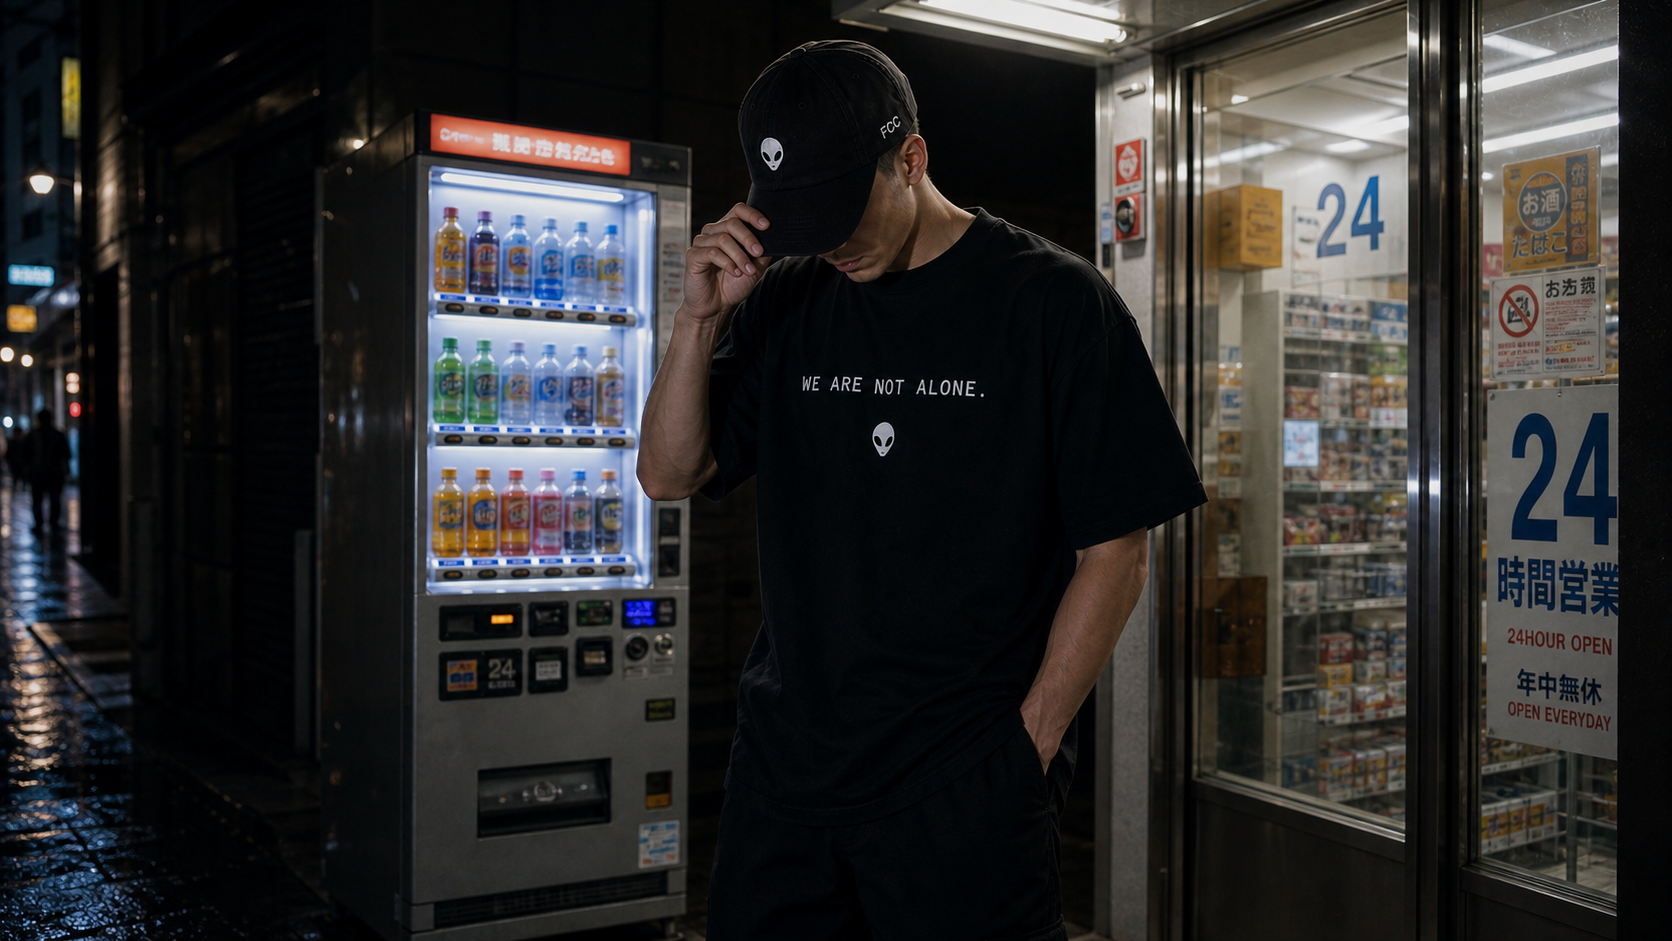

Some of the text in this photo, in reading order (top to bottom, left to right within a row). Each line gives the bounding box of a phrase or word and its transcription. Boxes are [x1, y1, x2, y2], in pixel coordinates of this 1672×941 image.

[879, 115, 901, 139] FCC
[1317, 175, 1384, 258] 24
[1522, 188, 1561, 215] お酒
[802, 375, 986, 398] WE ARE NOT ALONE.
[1511, 412, 1618, 546] 24
[1497, 555, 1618, 617] 時間営業
[1507, 627, 1613, 656] 24HOUR OPEN
[488, 658, 516, 679] 24
[1516, 668, 1603, 706] 年中無休
[1507, 701, 1612, 732] OPEN EVERYDAY
